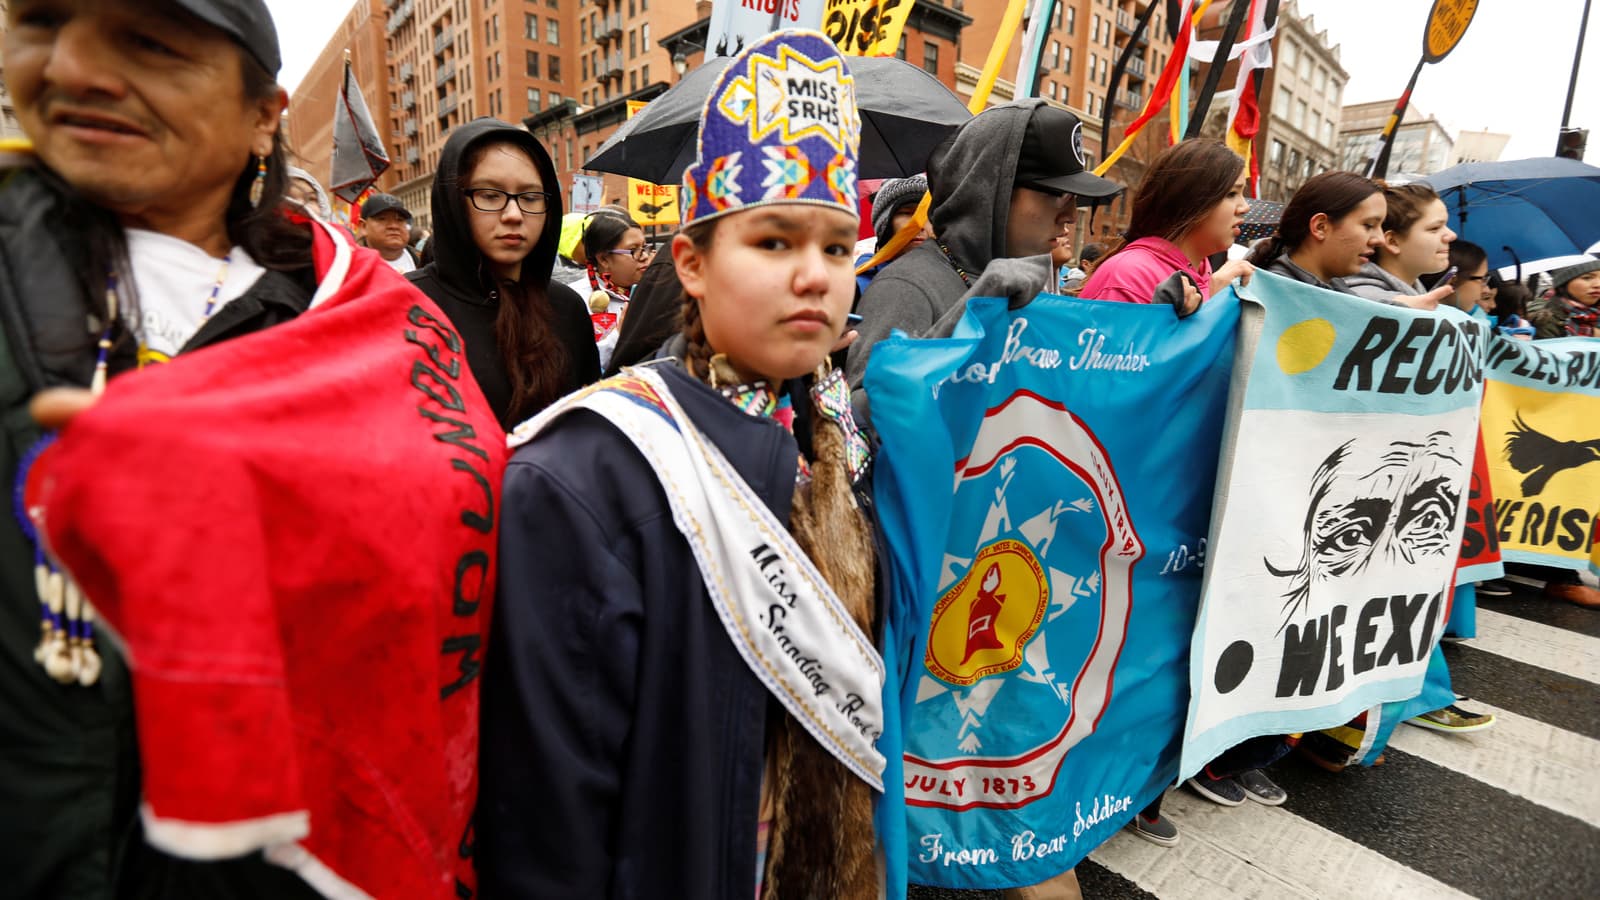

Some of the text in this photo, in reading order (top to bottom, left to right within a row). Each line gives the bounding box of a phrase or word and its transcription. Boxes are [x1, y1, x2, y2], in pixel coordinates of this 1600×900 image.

[787, 78, 837, 104] MISS
[787, 101, 839, 127] SRHS
[635, 184, 651, 196] WE
[1000, 317, 1063, 368] Brave
[1069, 328, 1150, 372] Thunder
[750, 543, 798, 609] Miss
[759, 603, 831, 698] Standing
[1275, 590, 1444, 698] WE EXI
[905, 774, 1036, 797] JULY 1873
[919, 794, 1133, 867] From Bear Soldier
